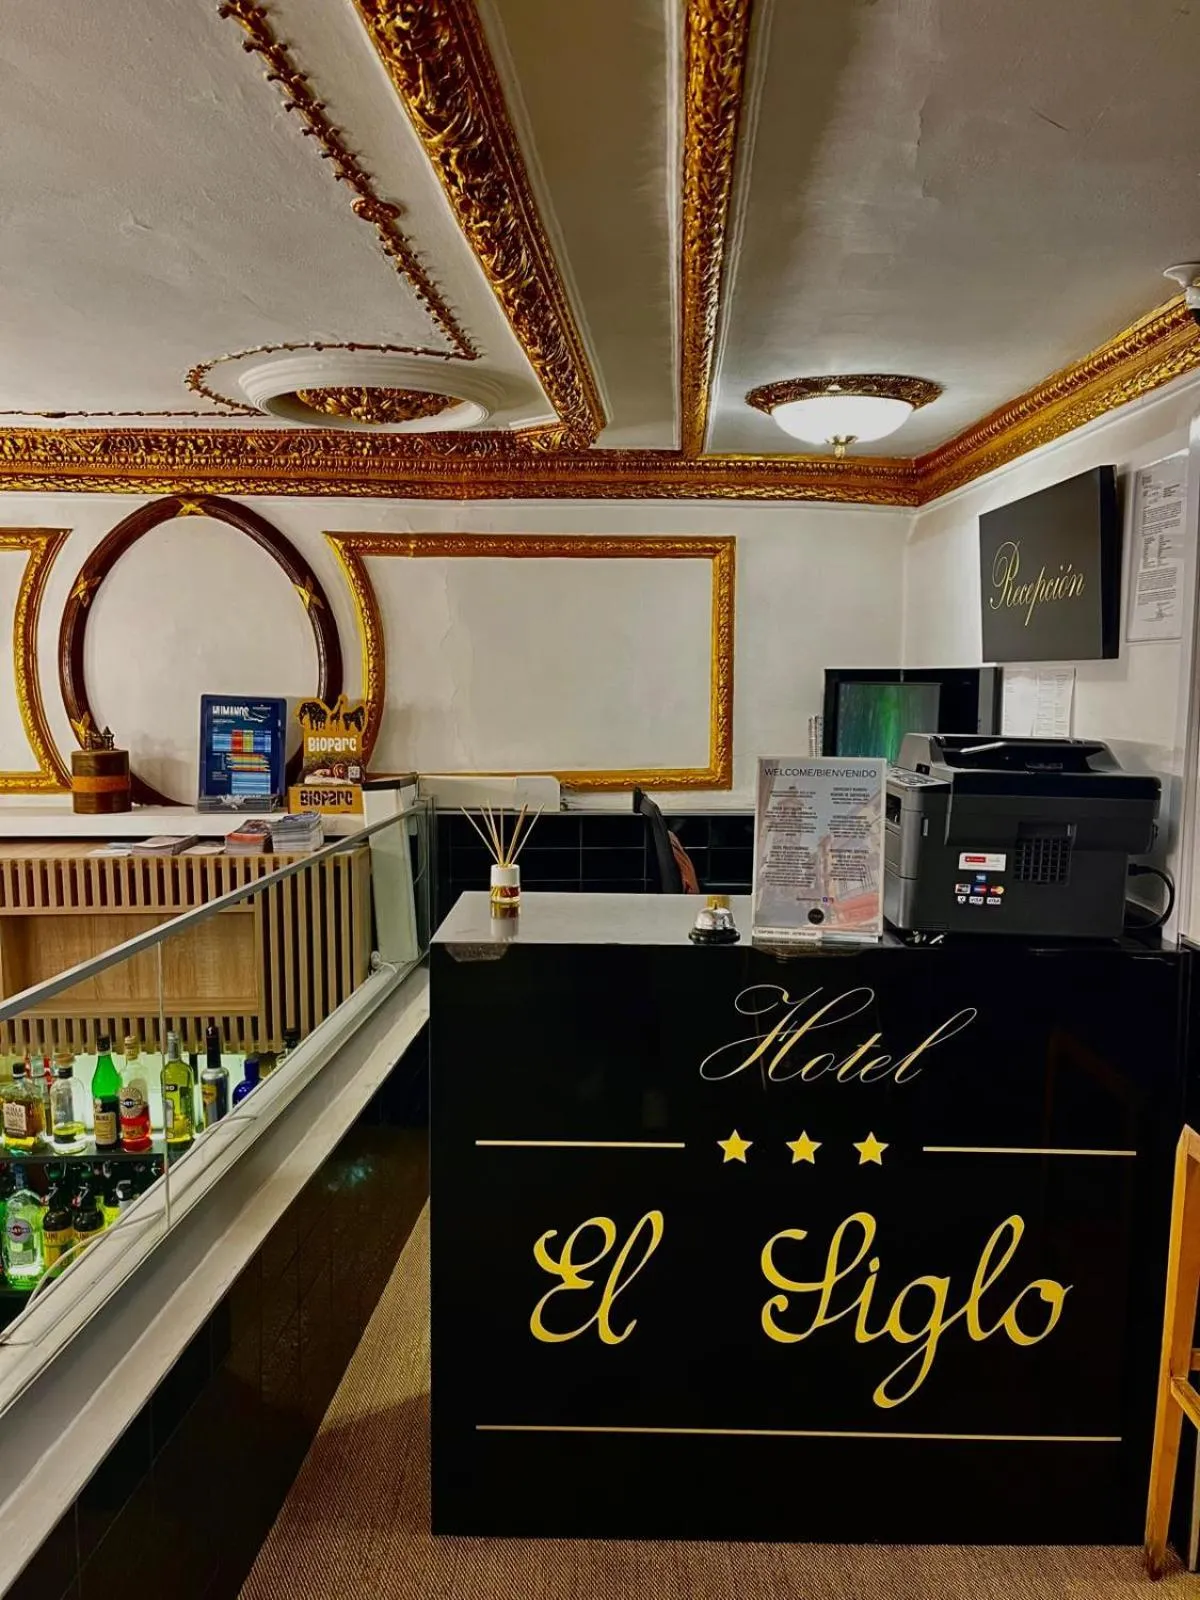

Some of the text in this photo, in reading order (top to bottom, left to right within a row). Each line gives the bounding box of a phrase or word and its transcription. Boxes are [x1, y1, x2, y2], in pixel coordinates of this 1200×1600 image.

[989, 540, 1085, 626] Recepción
[764, 767, 877, 778] WELCOME/BIENVENIDO
[699, 983, 978, 1084] Hotel
[530, 1210, 1073, 1409] El Siglo
